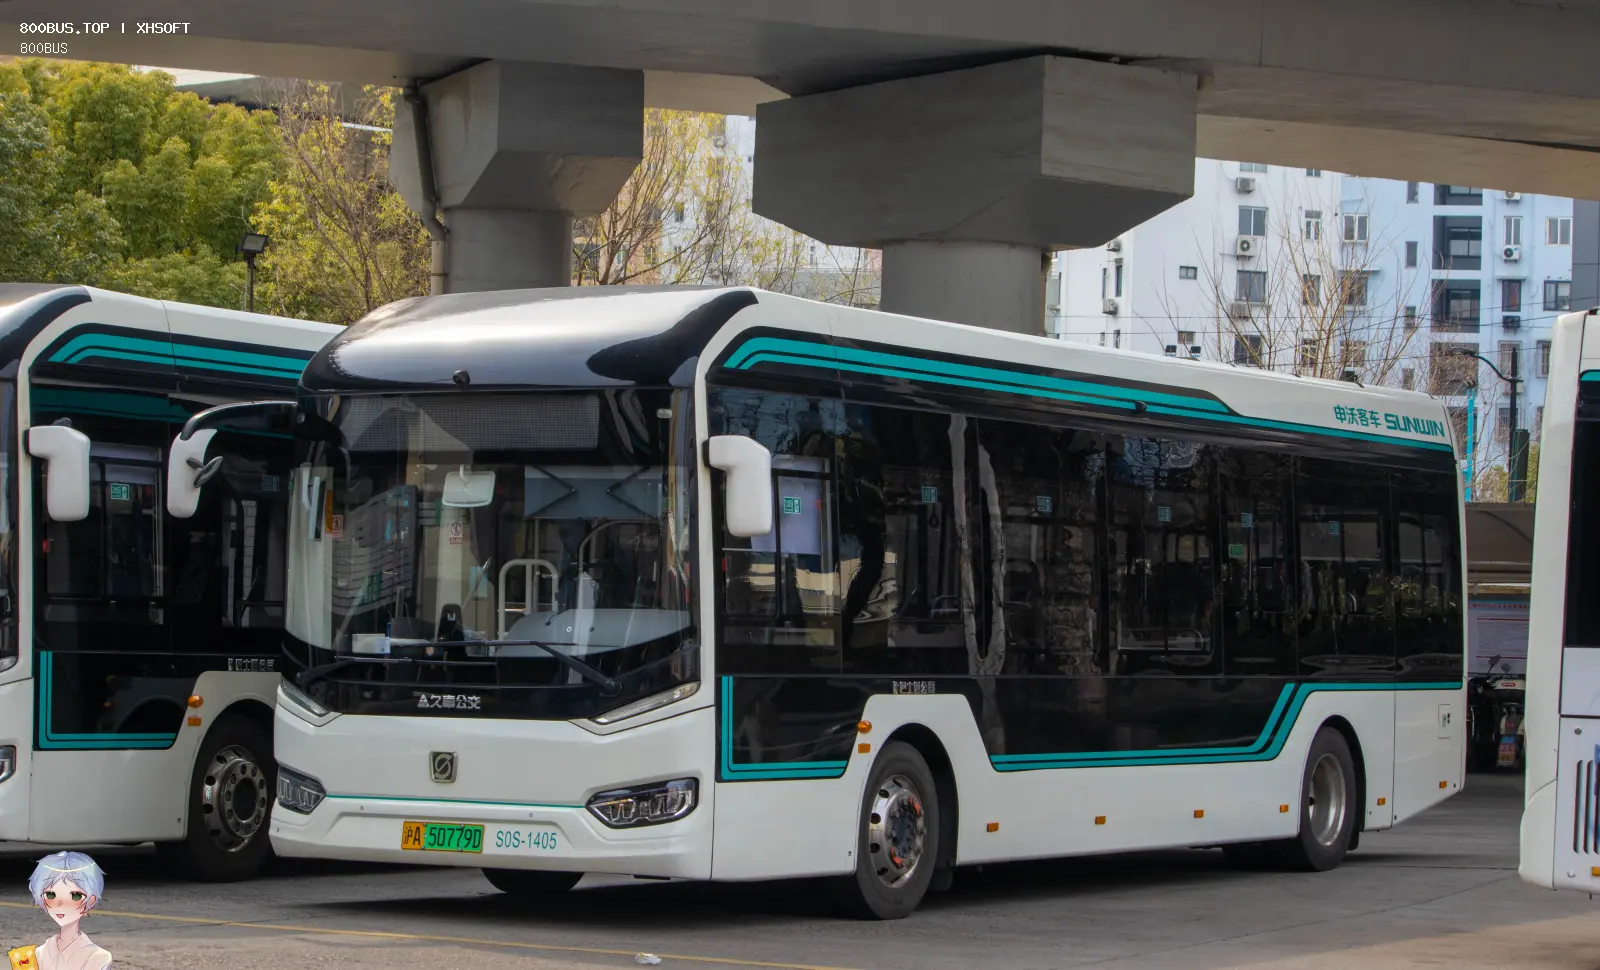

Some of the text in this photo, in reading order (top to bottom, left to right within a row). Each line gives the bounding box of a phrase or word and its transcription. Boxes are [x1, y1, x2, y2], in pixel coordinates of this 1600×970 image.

[1334, 404, 1445, 437] 申沃客车 SUNWIN
